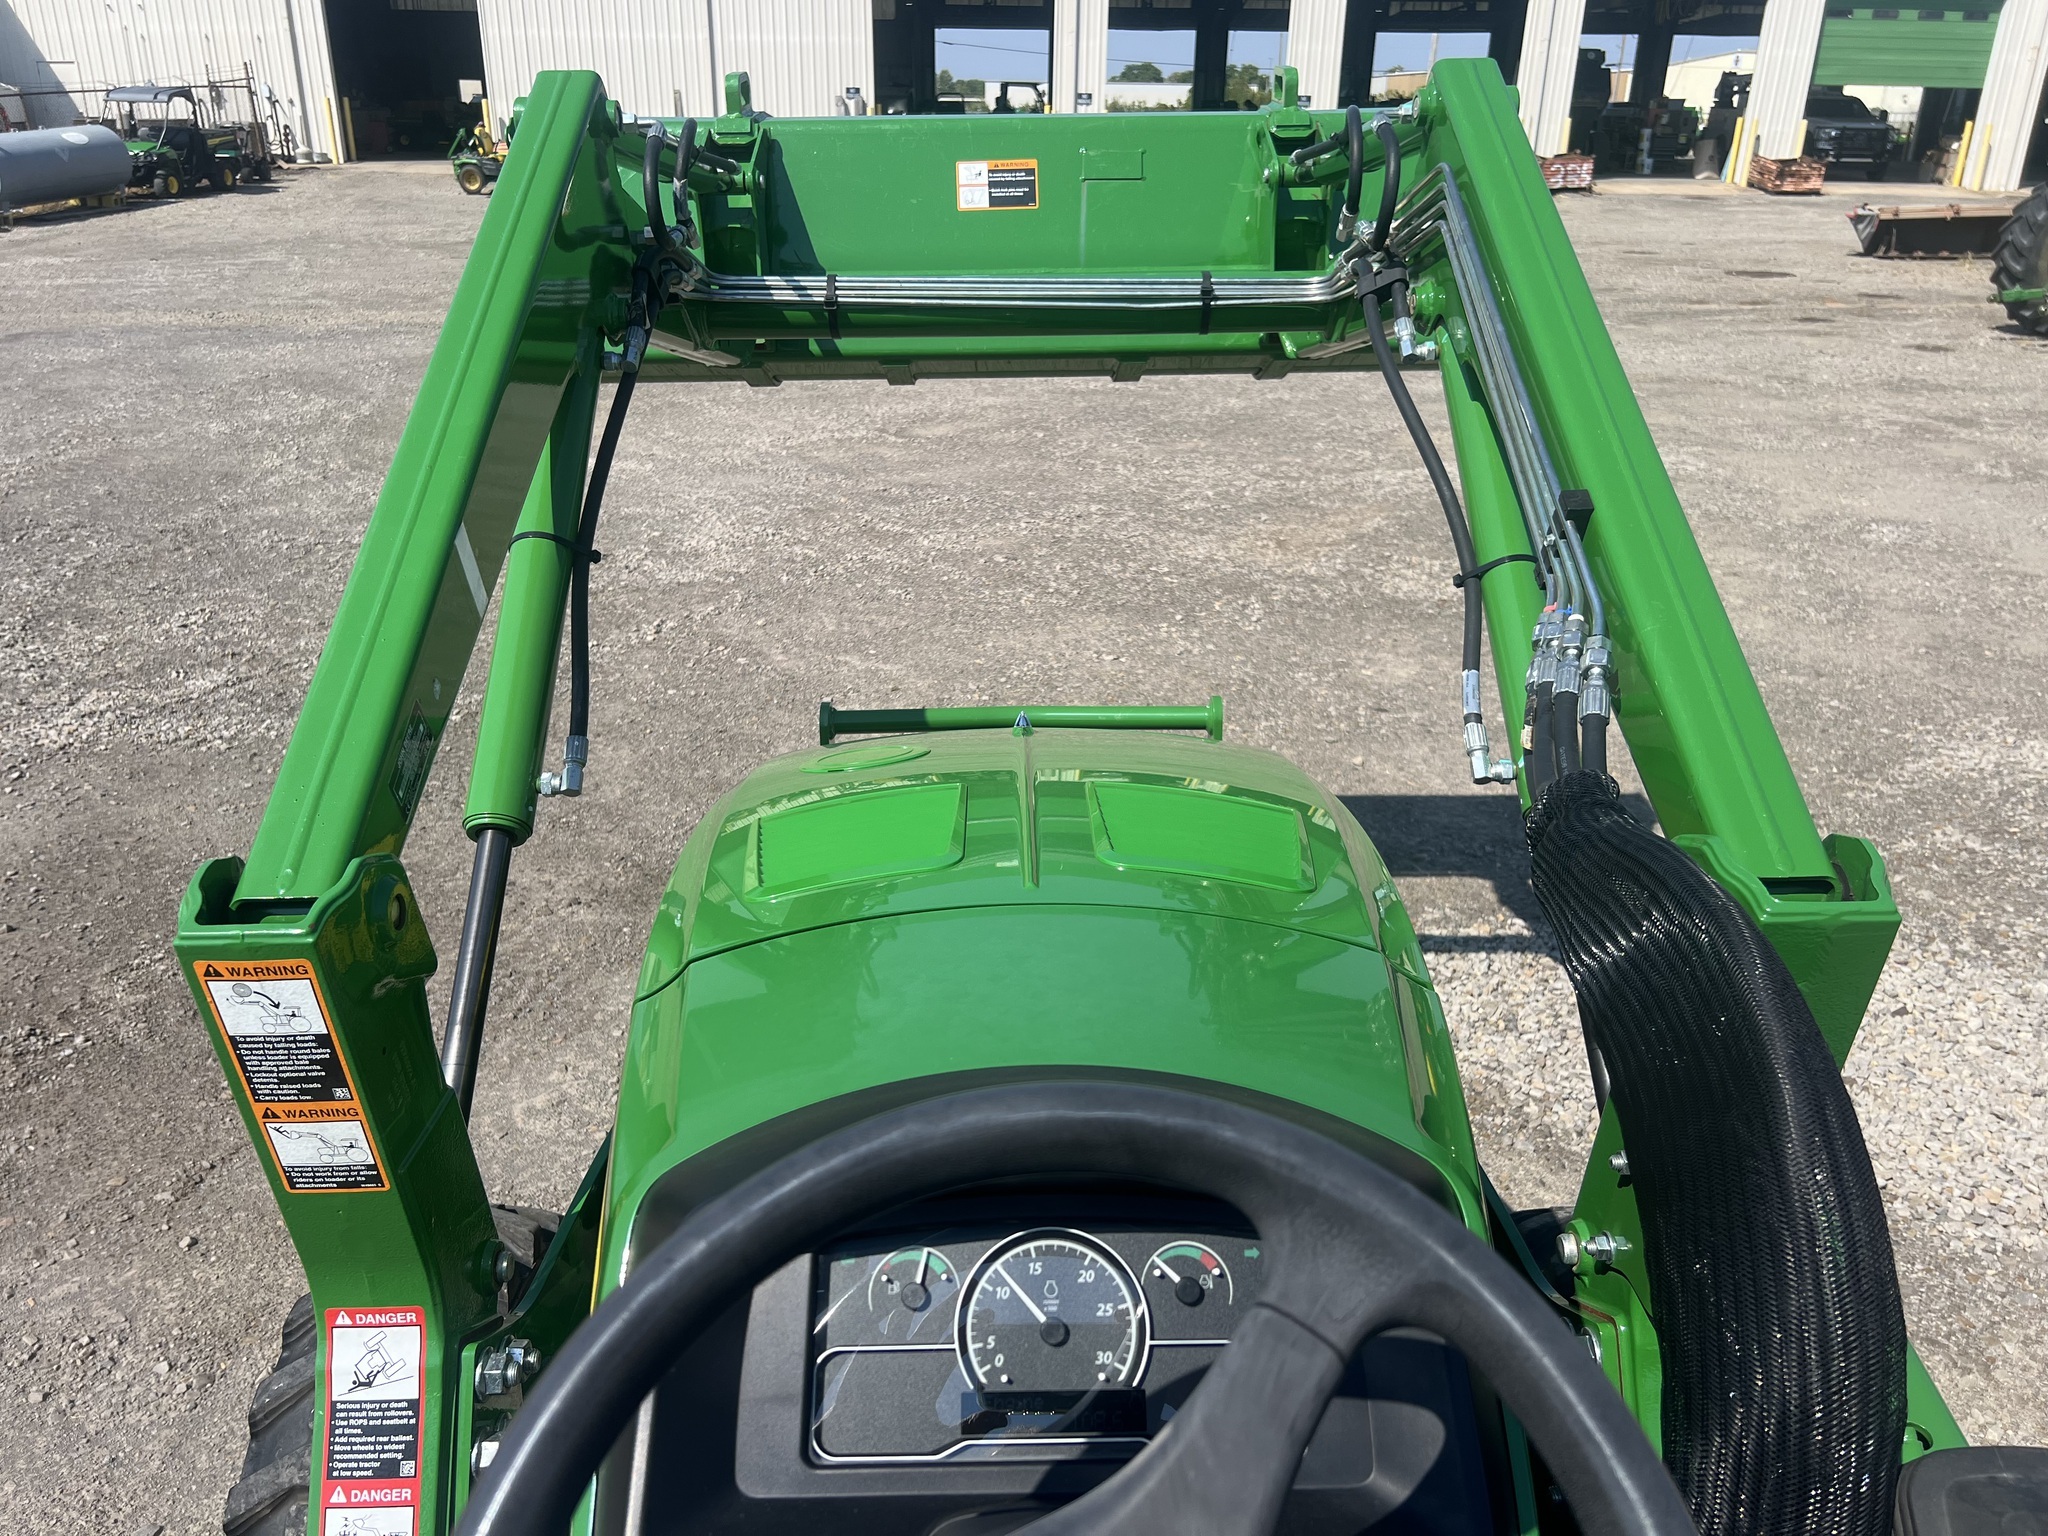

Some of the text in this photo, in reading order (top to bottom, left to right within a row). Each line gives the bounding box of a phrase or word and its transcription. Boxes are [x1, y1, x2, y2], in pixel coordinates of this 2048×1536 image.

[226, 965, 308, 977] WARNING
[282, 1108, 359, 1118] WARNING
[1028, 1262, 1042, 1275] 15
[1078, 1270, 1095, 1283] 20
[995, 1286, 1010, 1300] 10
[1096, 1303, 1114, 1316] 25
[356, 1312, 416, 1324] DANGER
[986, 1335, 996, 1349] 5
[994, 1354, 1004, 1367] 0
[1095, 1351, 1113, 1365] 30
[351, 1488, 412, 1502] DANGER
